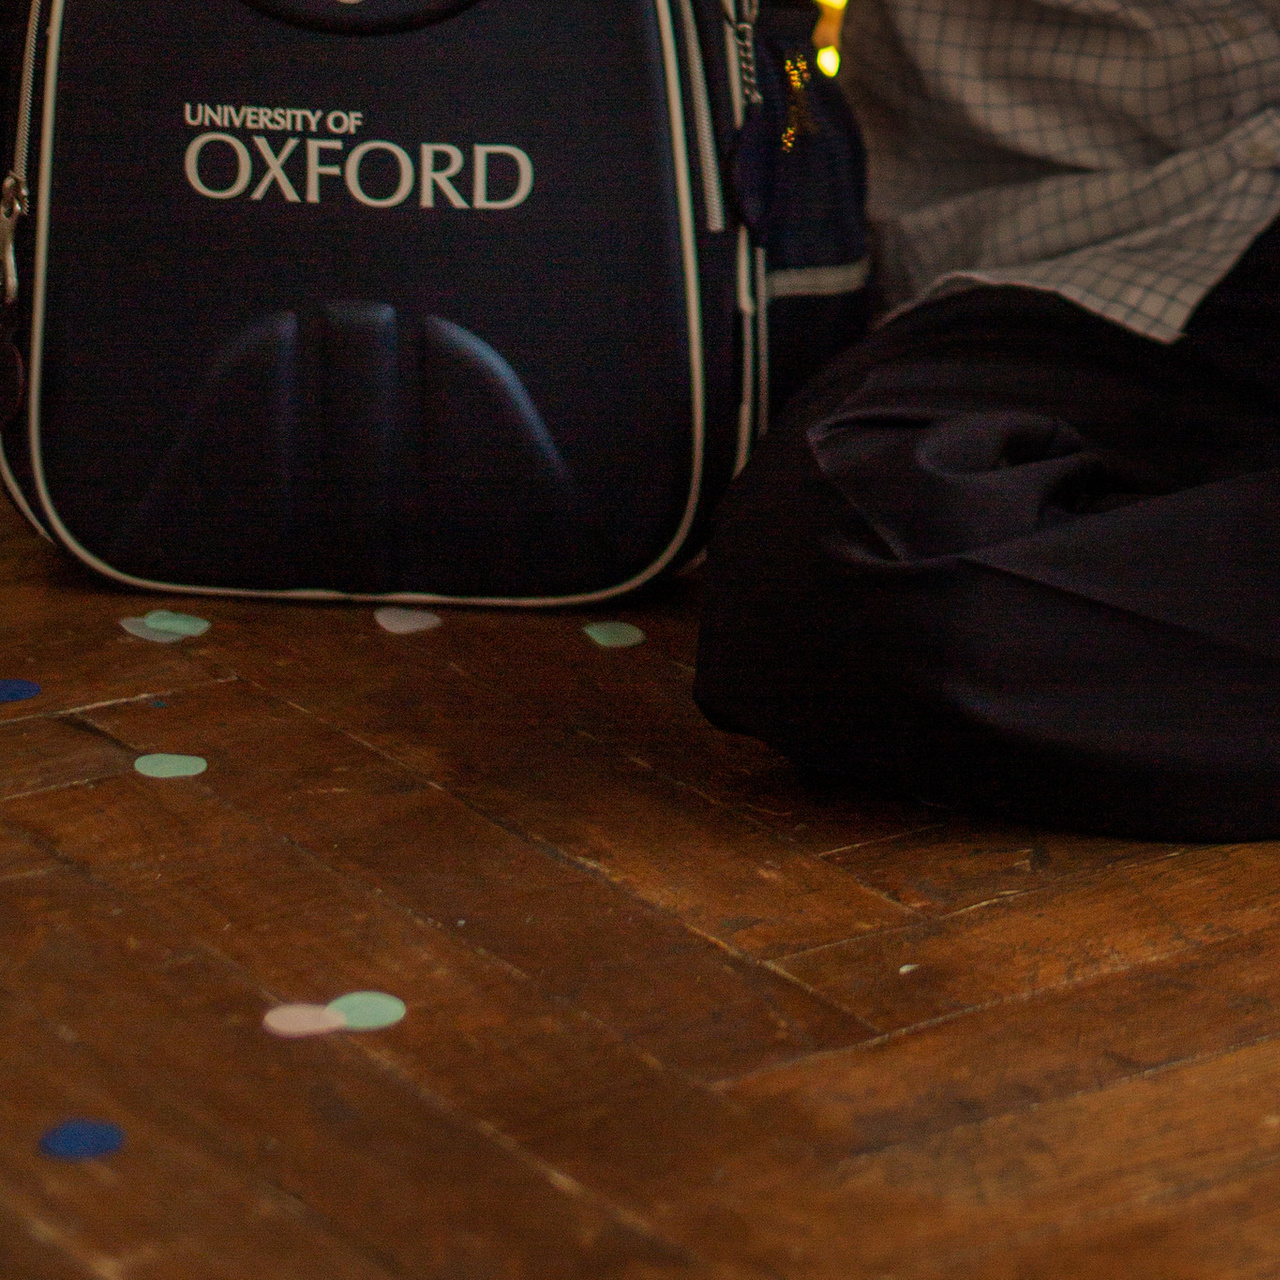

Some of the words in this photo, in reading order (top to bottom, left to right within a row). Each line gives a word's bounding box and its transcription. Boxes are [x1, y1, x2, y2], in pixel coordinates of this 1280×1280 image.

[184, 103, 322, 132] UNIVERSITY
[326, 111, 363, 134] OF
[184, 132, 534, 210] OXFORD
